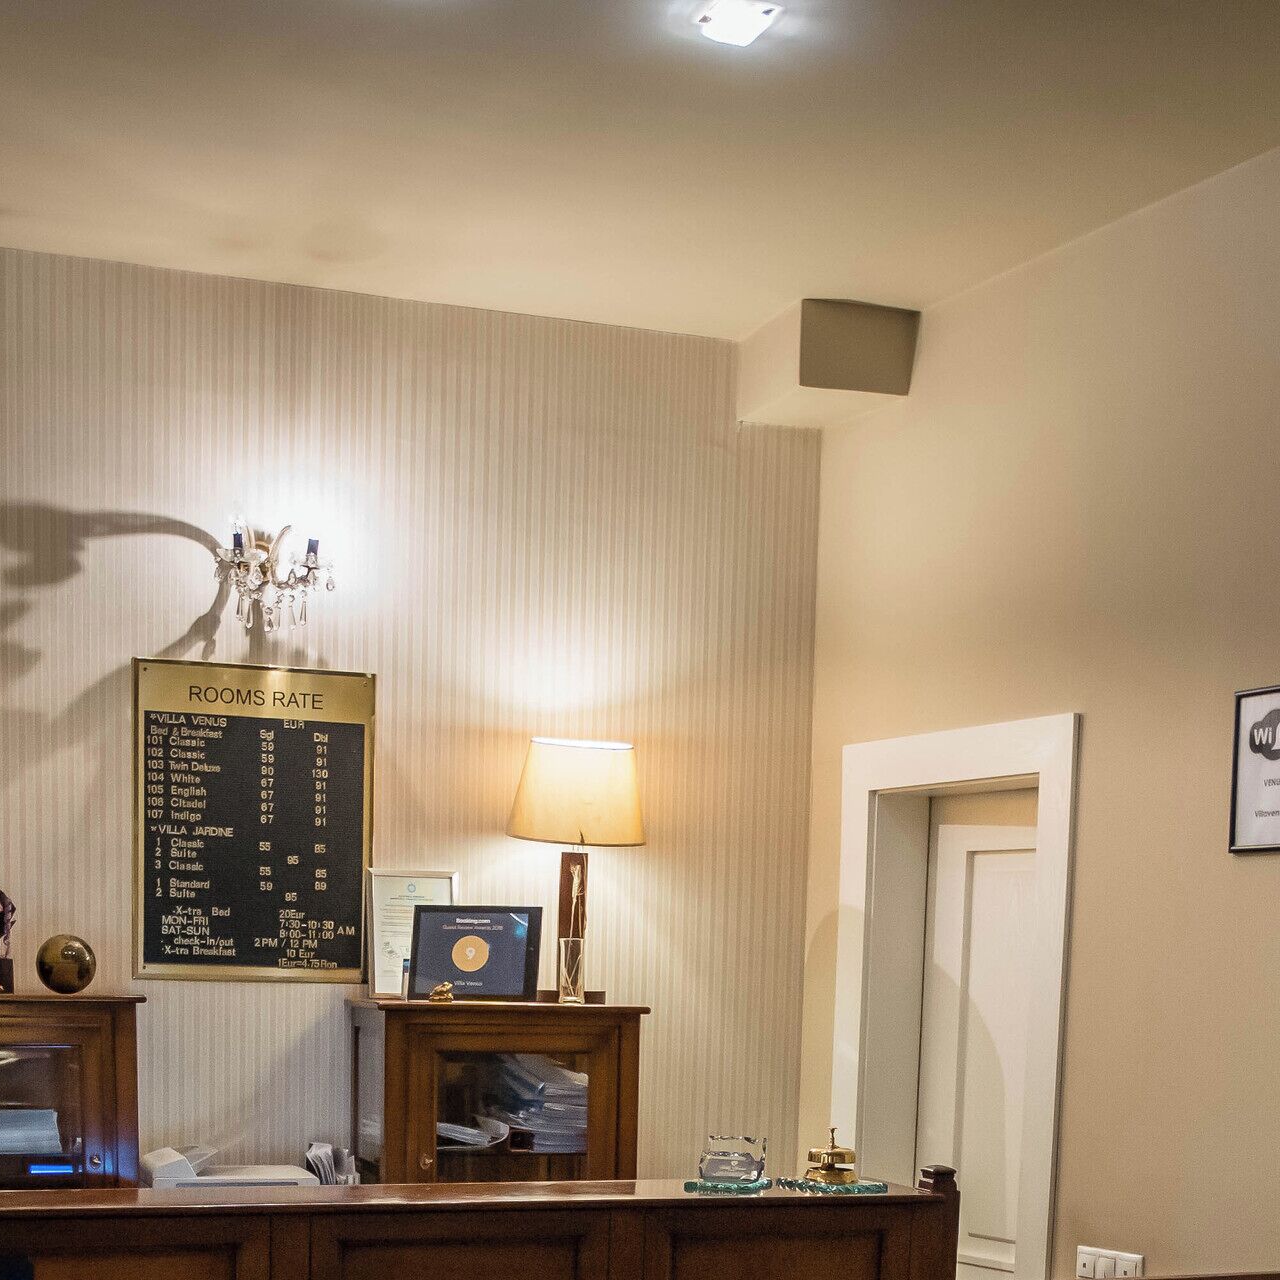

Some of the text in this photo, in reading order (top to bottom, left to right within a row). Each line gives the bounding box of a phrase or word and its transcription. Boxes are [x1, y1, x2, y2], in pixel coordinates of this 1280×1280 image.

[189, 685, 324, 710] ROOMS RATE
[191, 715, 227, 727] VENUS
[283, 720, 305, 729] EUR
[150, 725, 168, 735] Bed
[172, 727, 179, 736] &
[181, 727, 223, 739] Breakfast
[260, 729, 274, 741] Sgl
[146, 735, 327, 755] 101 Classic 59 91
[147, 748, 327, 767] 102 Classic 59 91
[147, 760, 328, 778] 103 Twin Deluxe 90 130
[147, 772, 326, 790] 104 White 67 91
[147, 785, 326, 802] 105 English 67 91
[170, 798, 206, 809] Citadel
[260, 803, 274, 812] 67
[315, 805, 326, 814] 91
[147, 809, 326, 826] 107 Indigo 67 91
[192, 826, 234, 837] JARDINE
[156, 837, 161, 846] 1
[171, 838, 205, 849] Classic
[259, 842, 271, 851] 55
[155, 847, 299, 865] 2 Suite 95
[155, 860, 327, 878] 3 Classic 55 85
[156, 878, 161, 887] 1
[169, 878, 210, 889] Standard
[260, 881, 273, 891] 59
[155, 888, 297, 901] 2 Suite 95
[211, 907, 231, 916] Bed
[161, 915, 209, 925] MON-FRI
[161, 925, 210, 935] SAT-SUN
[336, 926, 355, 935] AM
[192, 946, 237, 957] Breakfast
[286, 949, 296, 958] 10
[298, 949, 315, 958] Eur
[290, 939, 299, 948] 12
[302, 939, 318, 949] PM
